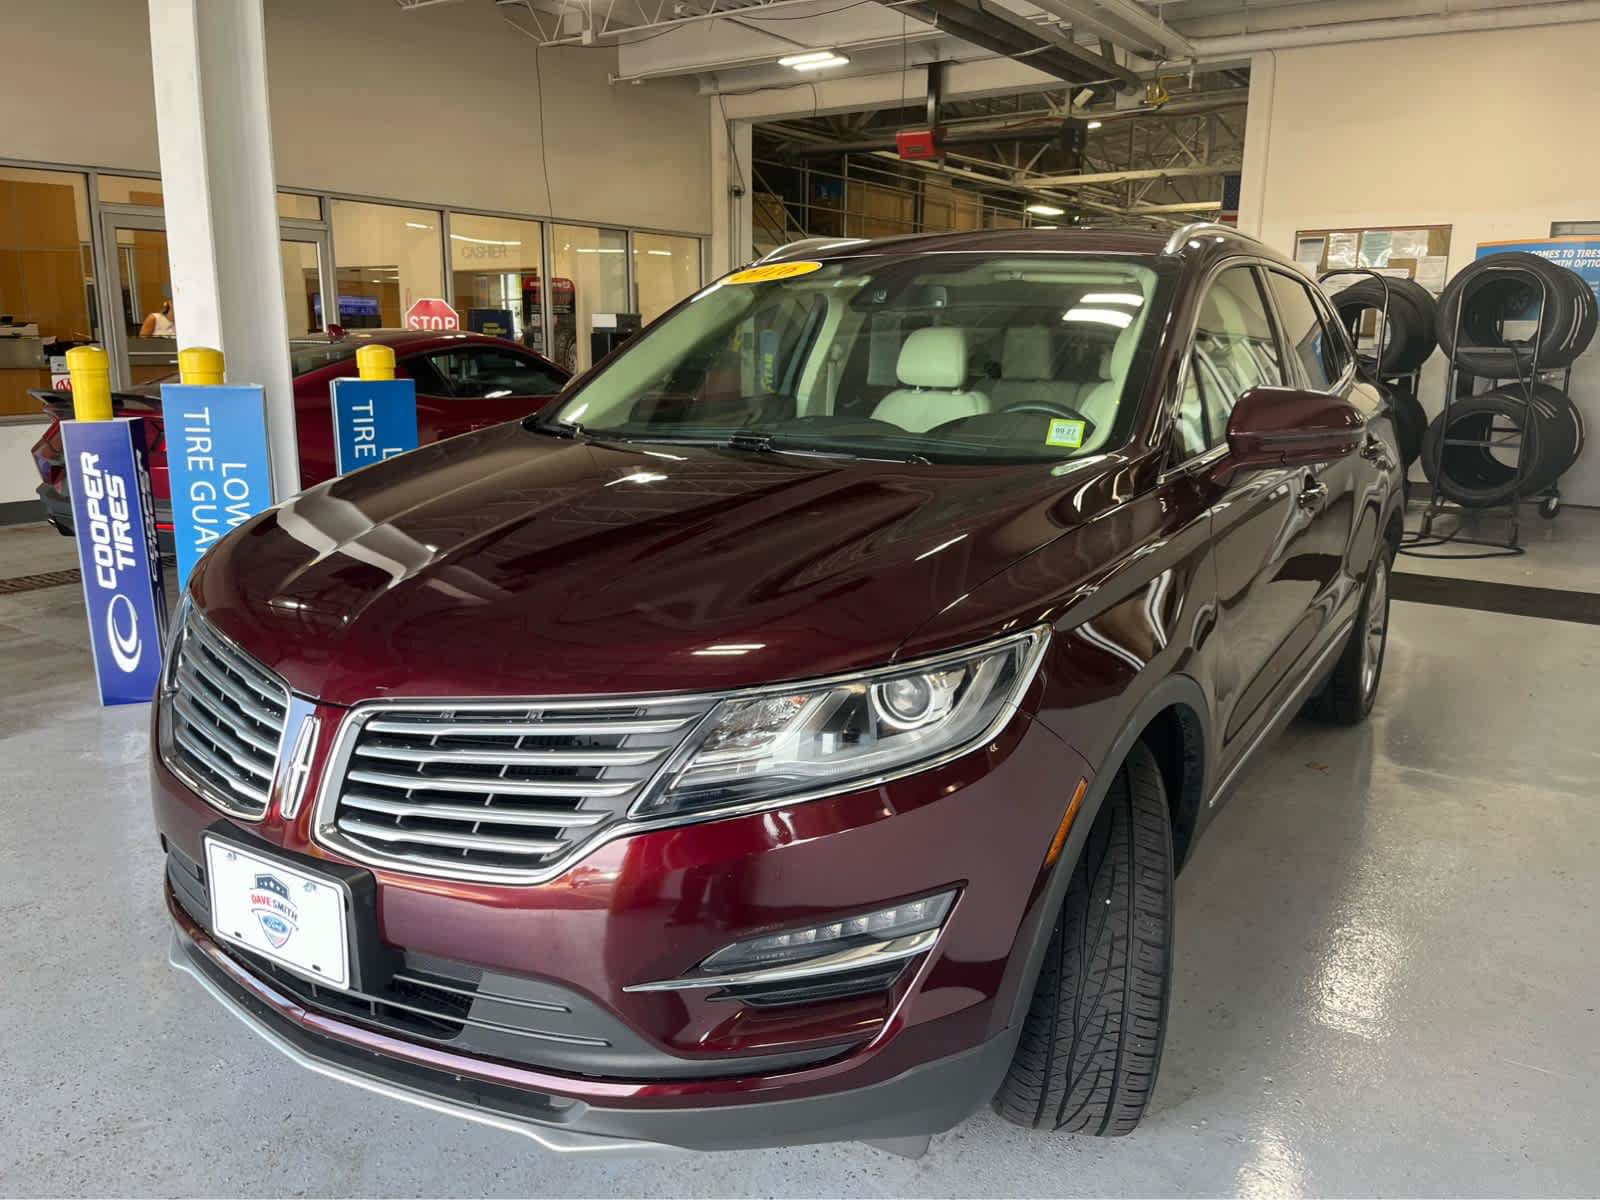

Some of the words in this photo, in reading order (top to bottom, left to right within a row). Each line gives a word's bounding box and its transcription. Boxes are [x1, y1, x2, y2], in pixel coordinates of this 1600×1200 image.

[1562, 249, 1574, 258] TO
[1574, 259, 1600, 268] OPTIO
[409, 315, 456, 331] STOP
[184, 407, 214, 472] TIRE
[351, 399, 377, 459] TIRE
[80, 451, 117, 590] COOPER
[105, 472, 137, 572] TIRES
[190, 480, 220, 553] GUA
[221, 462, 251, 528] LOW
[251, 894, 272, 907] DAVE
[272, 899, 298, 921] SMITH
